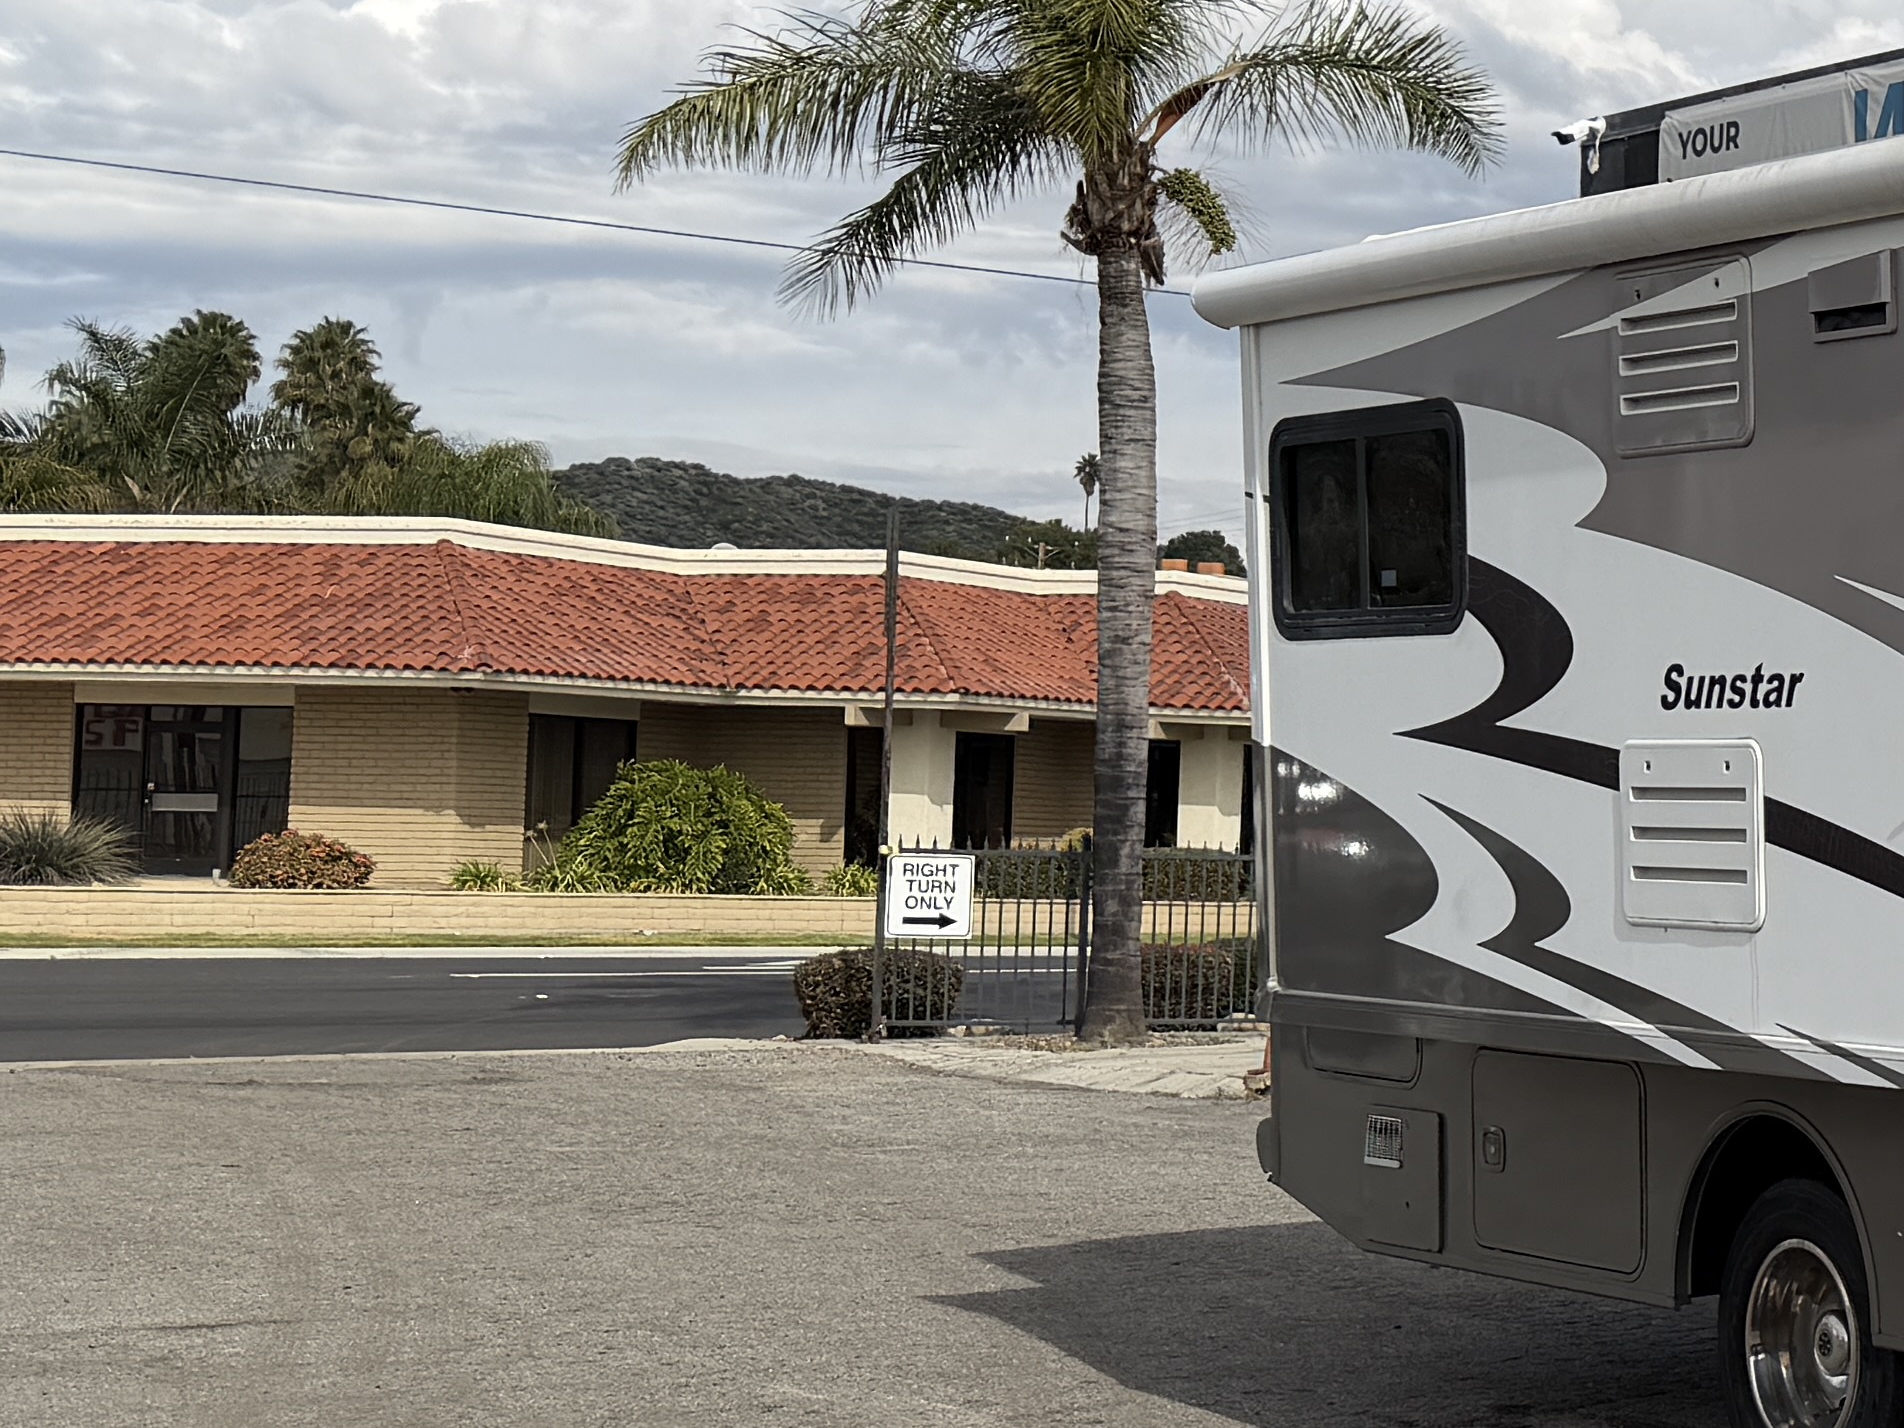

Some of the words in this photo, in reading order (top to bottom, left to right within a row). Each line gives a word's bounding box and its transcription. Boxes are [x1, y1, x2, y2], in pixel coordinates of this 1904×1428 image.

[1678, 120, 1740, 160] YOUR
[1660, 662, 1805, 711] Sunstar
[903, 863, 959, 877] RIGHT
[906, 880, 956, 894] TURN
[905, 896, 954, 910] ONLY
